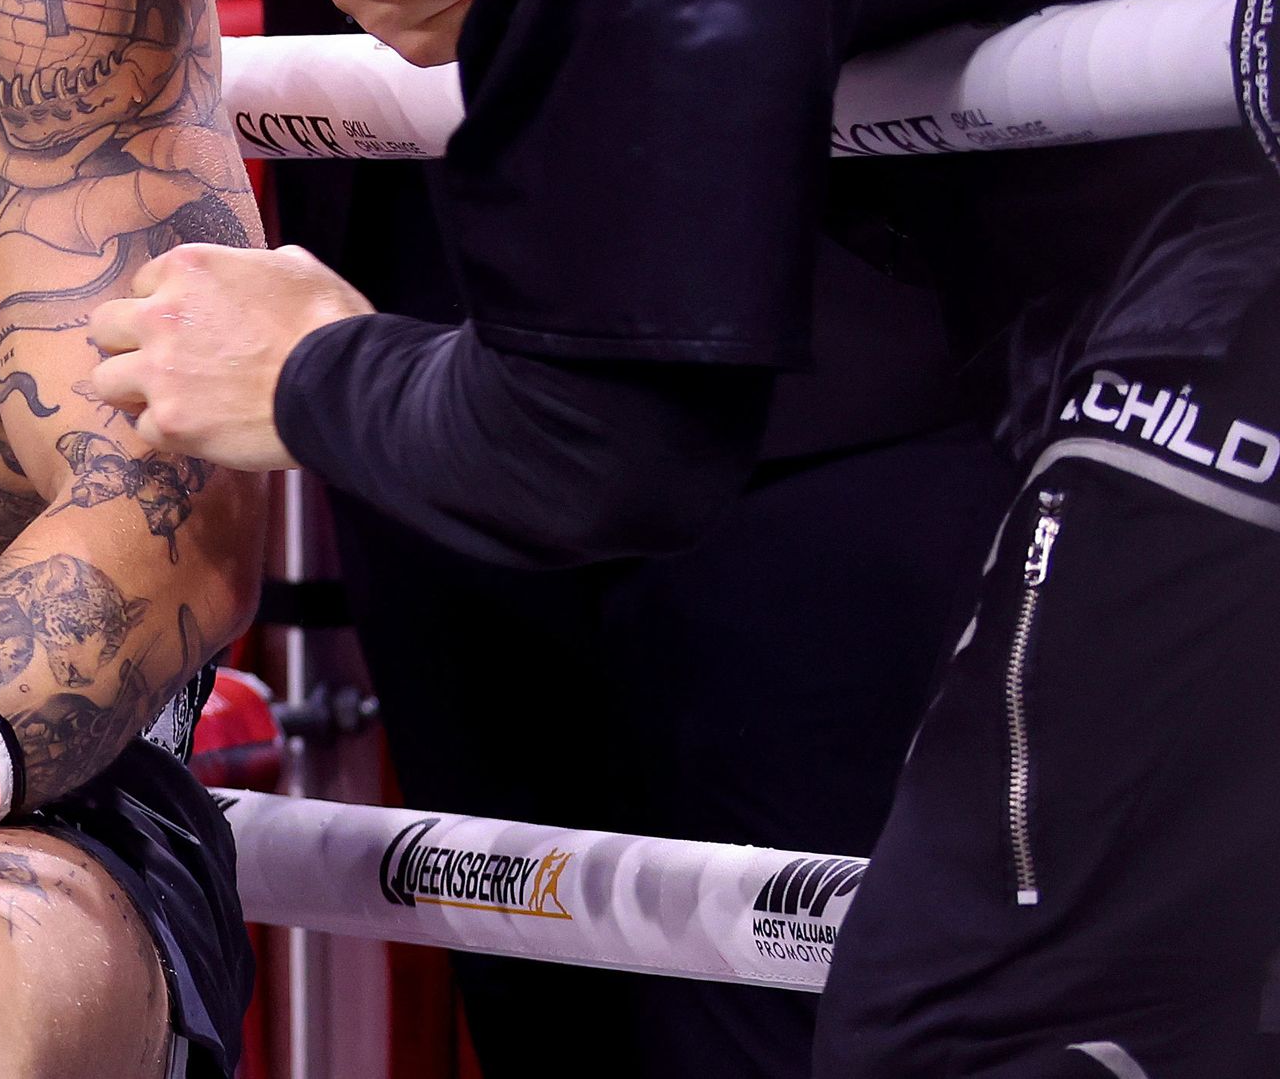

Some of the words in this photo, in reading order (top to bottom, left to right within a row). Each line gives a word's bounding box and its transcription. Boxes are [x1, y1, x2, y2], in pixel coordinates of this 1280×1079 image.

[342, 119, 377, 139] SKILL
[950, 108, 993, 131] SKILL
[380, 817, 539, 908] QUEENSBERRY
[752, 917, 786, 940] MOST
[754, 939, 834, 966] PROMOTIO
